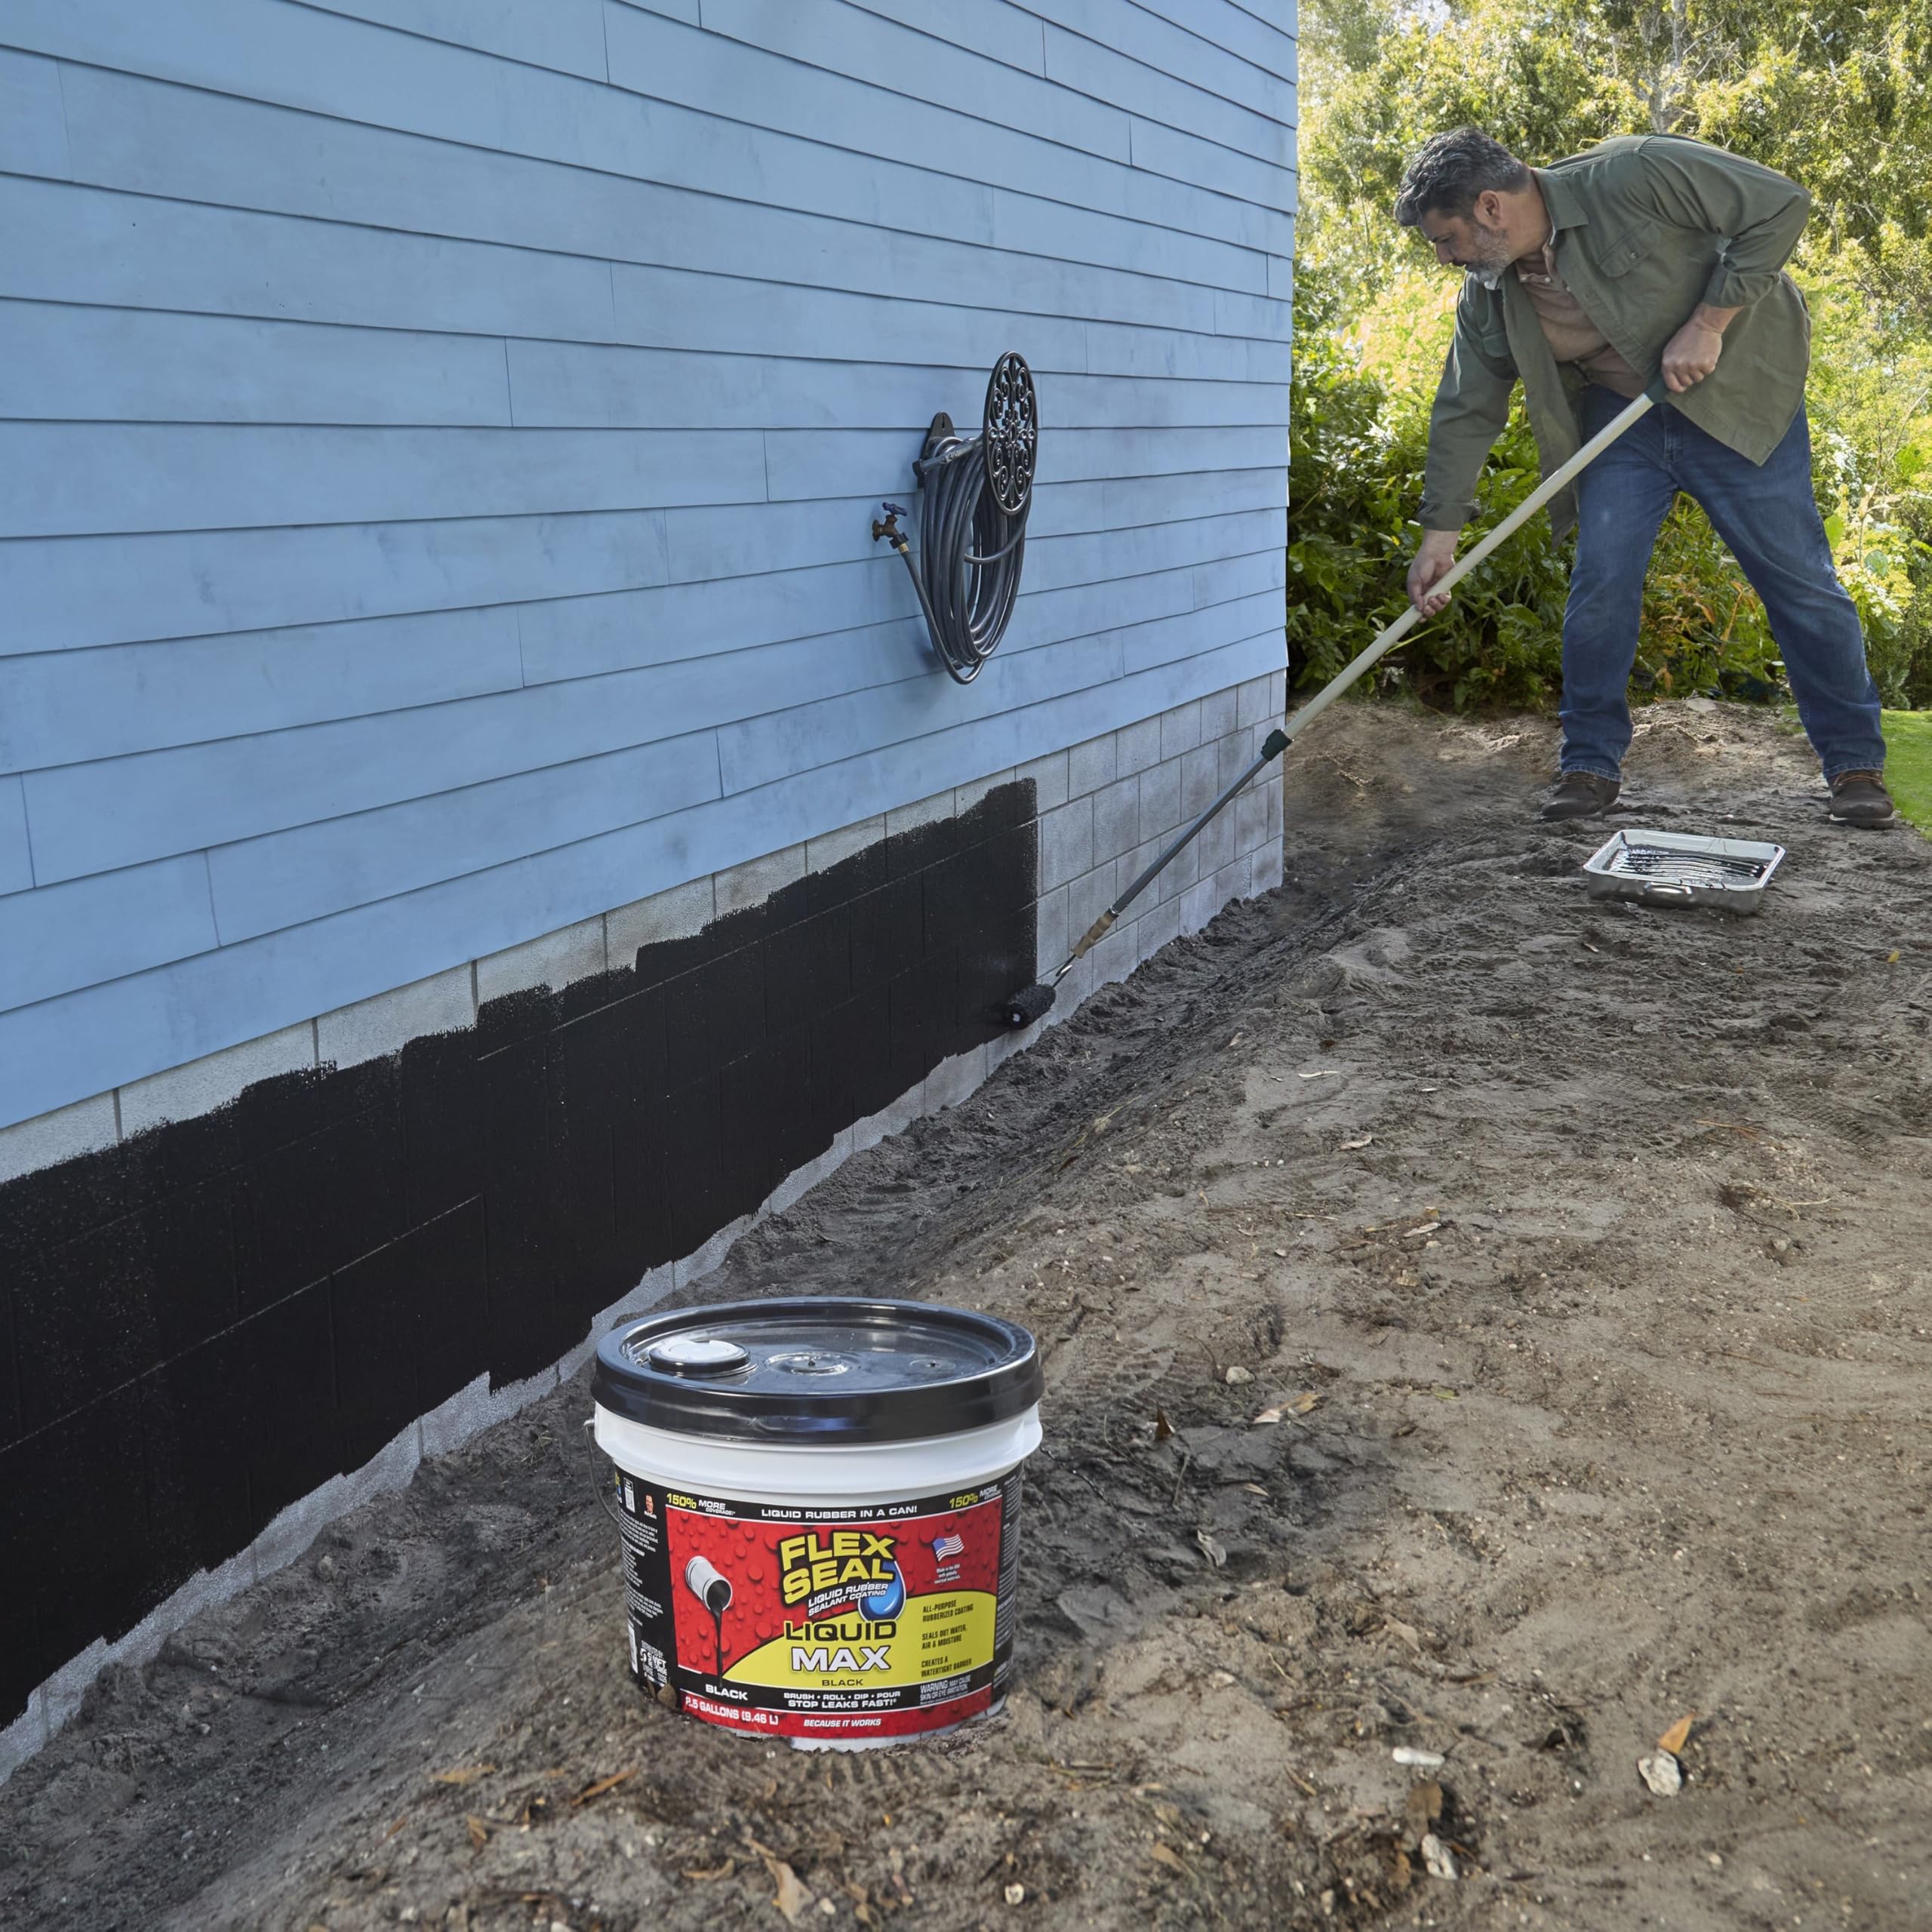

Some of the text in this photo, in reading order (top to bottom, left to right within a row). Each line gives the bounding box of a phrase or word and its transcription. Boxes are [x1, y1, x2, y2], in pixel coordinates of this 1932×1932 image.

[666, 1493, 725, 1509] 150% MORE
[949, 1493, 979, 1509] 150%
[980, 1484, 998, 1497] MORE
[761, 1509, 801, 1518] LIQUID
[888, 1506, 917, 1515] CAN!
[780, 1532, 895, 1571] FLEX
[783, 1558, 894, 1604] SEAL
[808, 1583, 889, 1608] LIQUID RUBBER
[808, 1590, 886, 1617] SEALANT COATING
[922, 1599, 956, 1614] ALL-PURPOSE
[922, 1610, 953, 1623] RUBBERIZED
[785, 1621, 897, 1641] LIQUID
[921, 1631, 938, 1641] SEALS
[940, 1629, 949, 1637] OUT
[921, 1641, 931, 1650] AIR
[791, 1645, 891, 1672] MAX
[921, 1657, 943, 1668] CREATES
[705, 1684, 749, 1701] BLACK
[699, 1701, 740, 1719] GALLONS
[741, 1710, 767, 1724] (9.46
[769, 1714, 778, 1725] L)
[804, 1718, 881, 1727] BECAUSE IT WORKS
